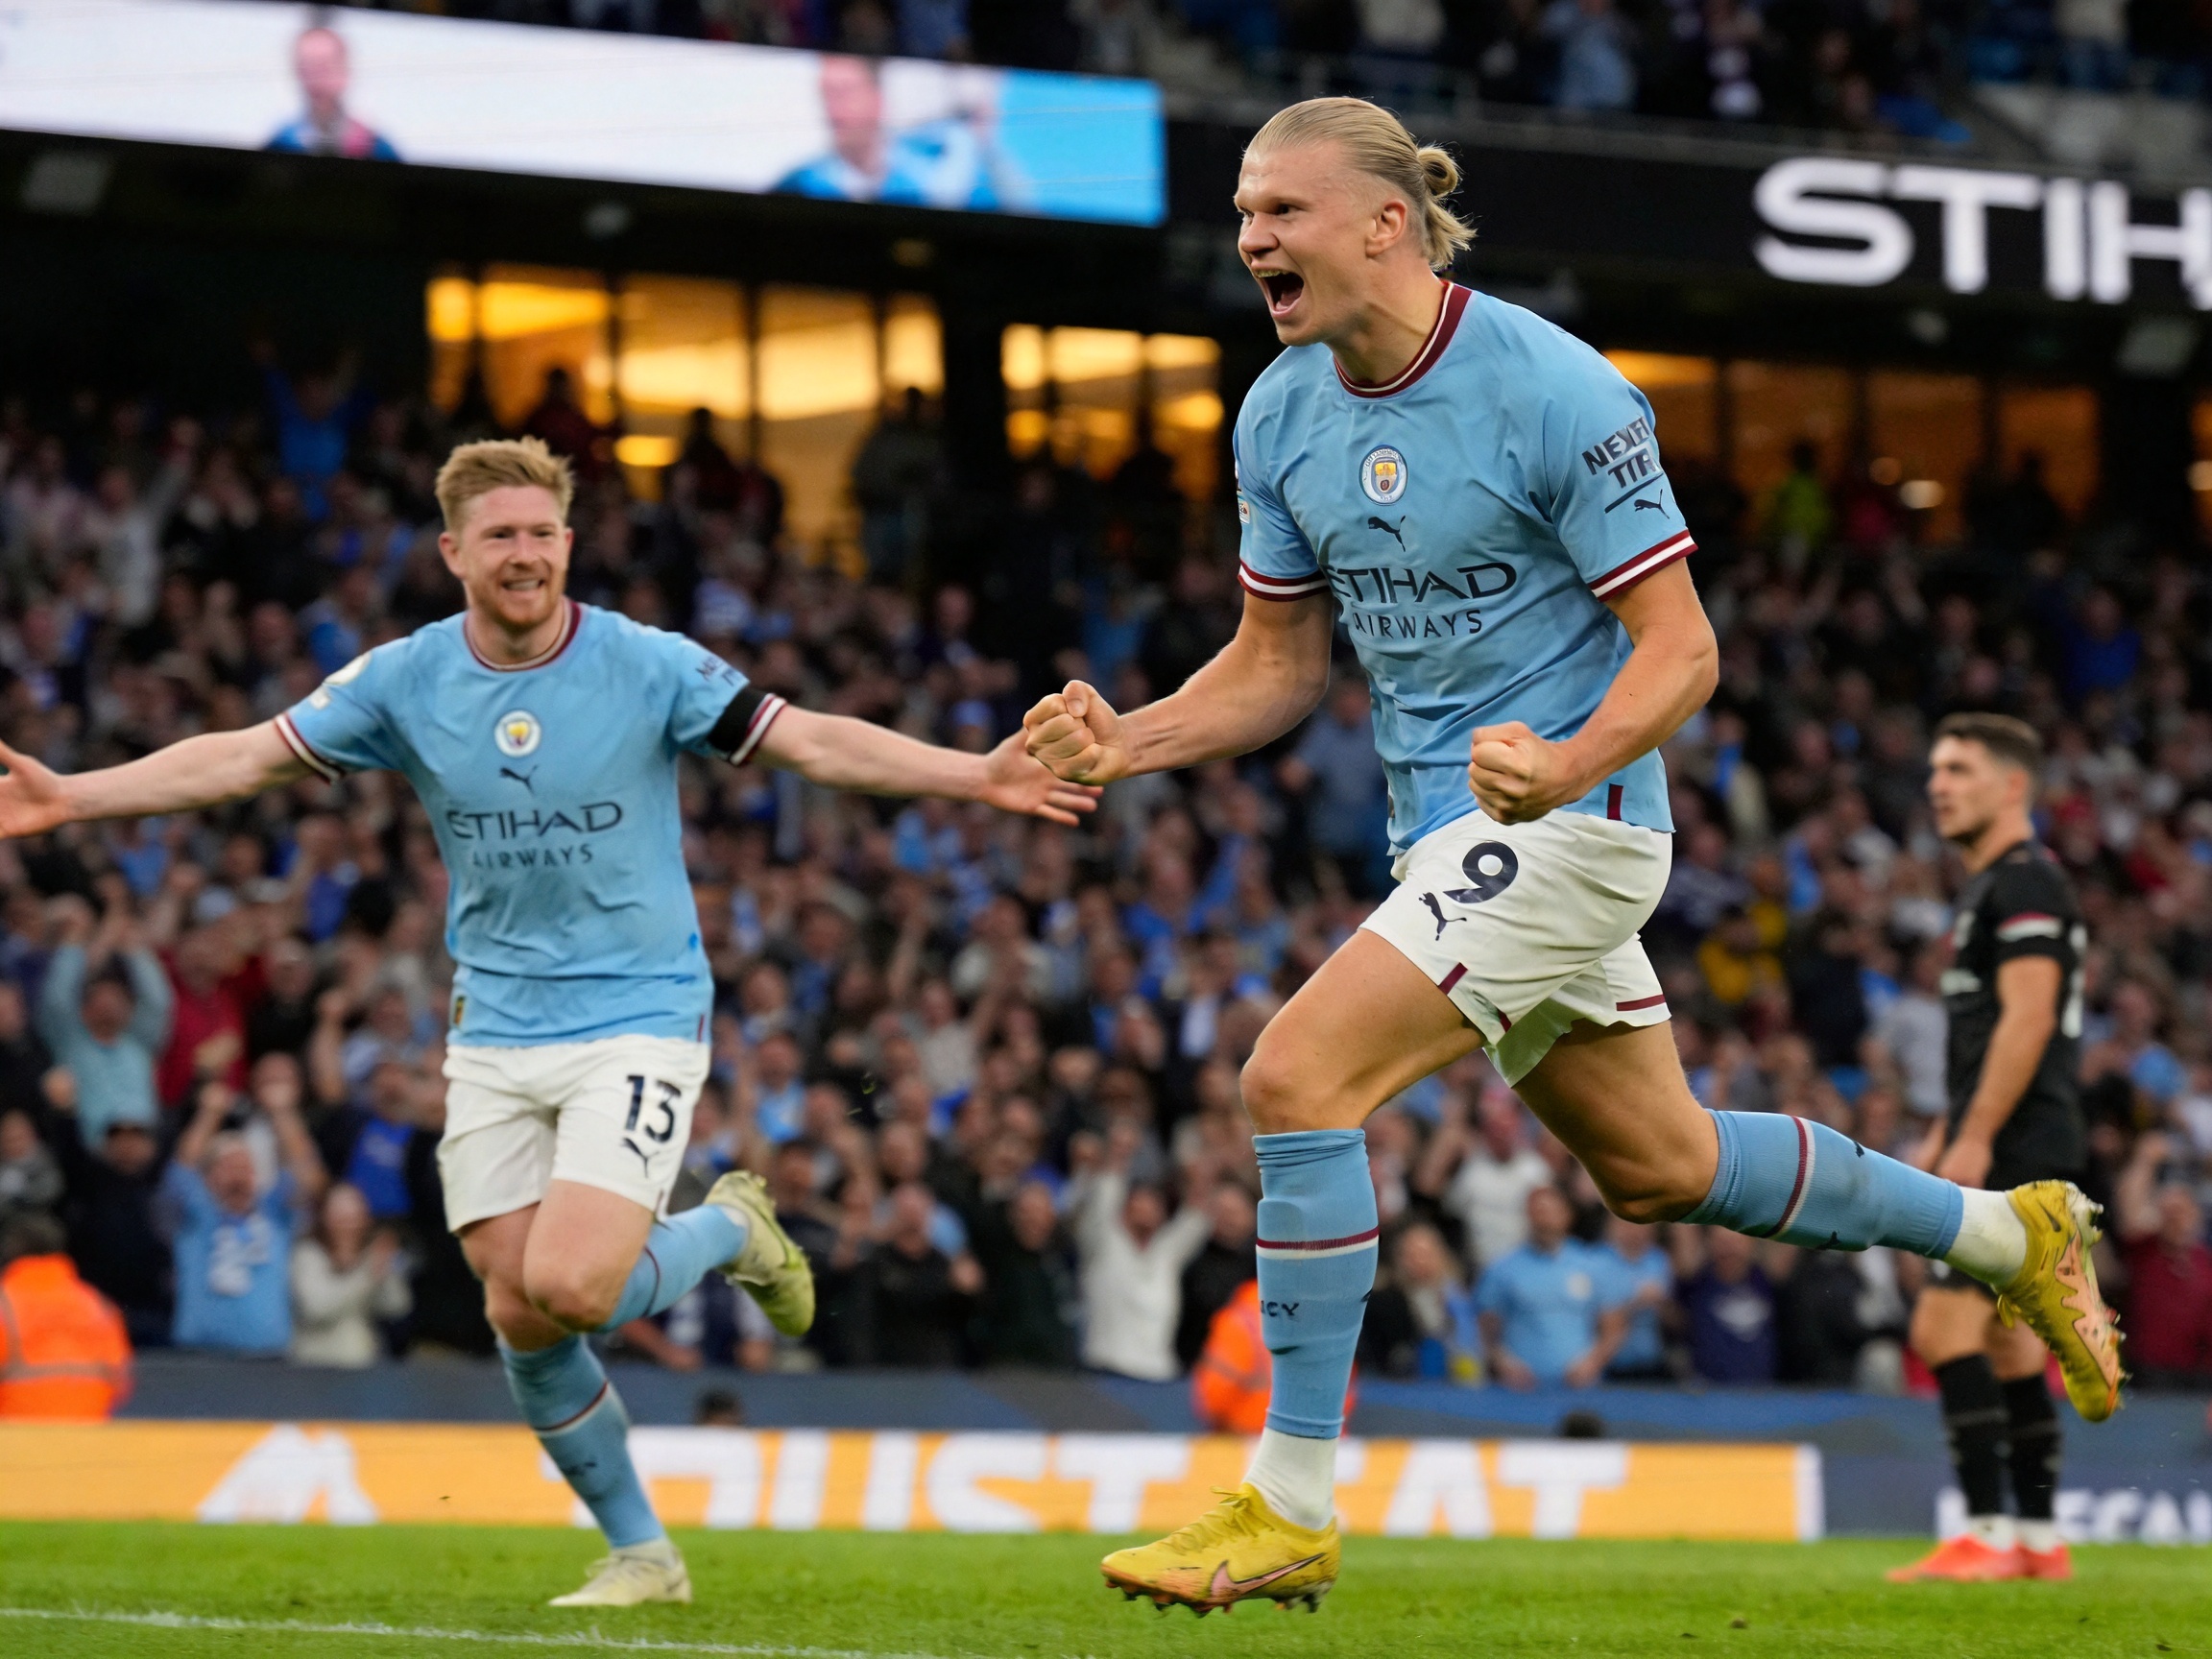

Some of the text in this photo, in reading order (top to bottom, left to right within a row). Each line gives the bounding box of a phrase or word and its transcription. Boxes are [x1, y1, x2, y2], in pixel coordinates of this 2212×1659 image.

[1753, 156, 2212, 311] STIH
[1352, 609, 1483, 638] AIRWAYS
[445, 801, 623, 841] ETIHAD
[472, 843, 594, 869] AIRWAYS
[1442, 839, 1520, 904] 9
